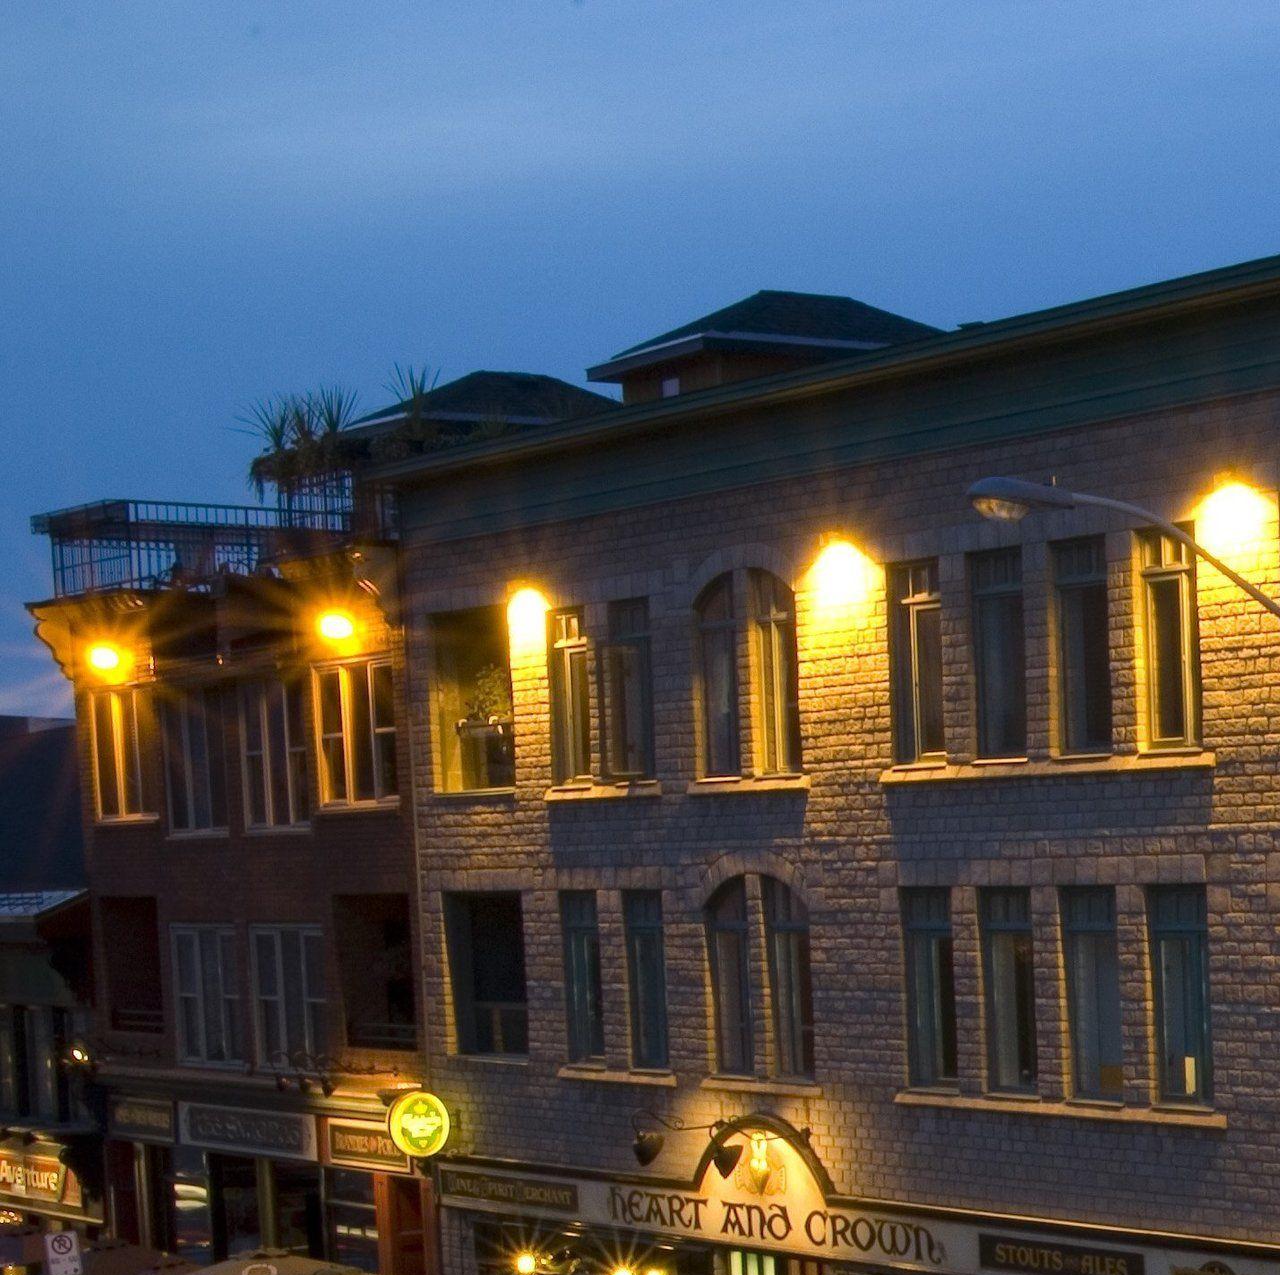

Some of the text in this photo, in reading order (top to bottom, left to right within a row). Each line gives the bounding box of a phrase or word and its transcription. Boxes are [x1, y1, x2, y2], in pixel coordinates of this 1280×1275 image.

[609, 1184, 942, 1264] HEART AND CROWN
[995, 1244, 1064, 1271] STOUTS
